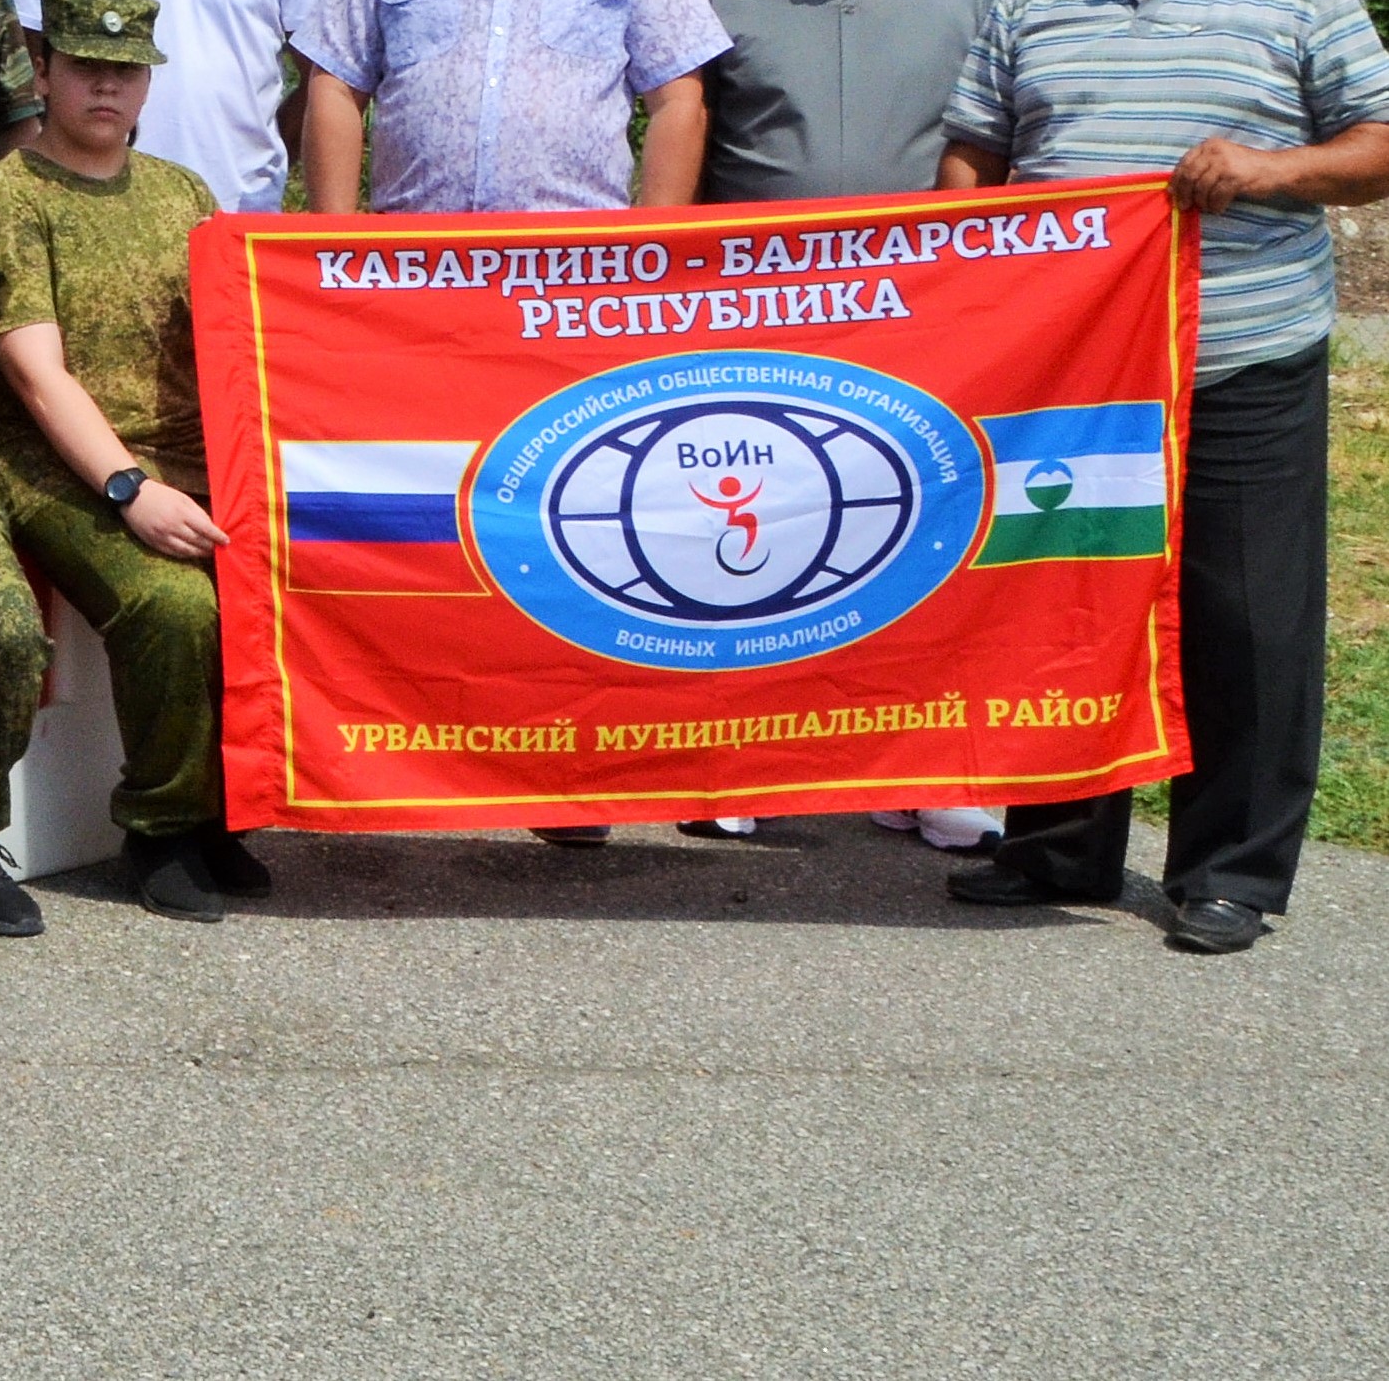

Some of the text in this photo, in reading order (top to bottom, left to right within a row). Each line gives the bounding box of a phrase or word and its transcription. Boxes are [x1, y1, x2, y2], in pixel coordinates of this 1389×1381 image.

[315, 238, 670, 297] КАБАРДИНО
[719, 205, 1111, 278] БАЛКАРСКАЯ
[516, 275, 912, 341] РЕСПУБЛИКА
[496, 366, 959, 505] ОБЩЕРОССИЙСКАЯ ОБЩЕСТВЕННАЯ ОРГАНИЗАЦИЯ
[677, 439, 774, 470] ВоИн
[615, 609, 862, 658] ВОЕННЫХ ИНВАЛИДОВ
[337, 687, 1124, 755] УРВАНСКИЙ МУНИЦИПАЛЬНЫЙ РАЙОН
